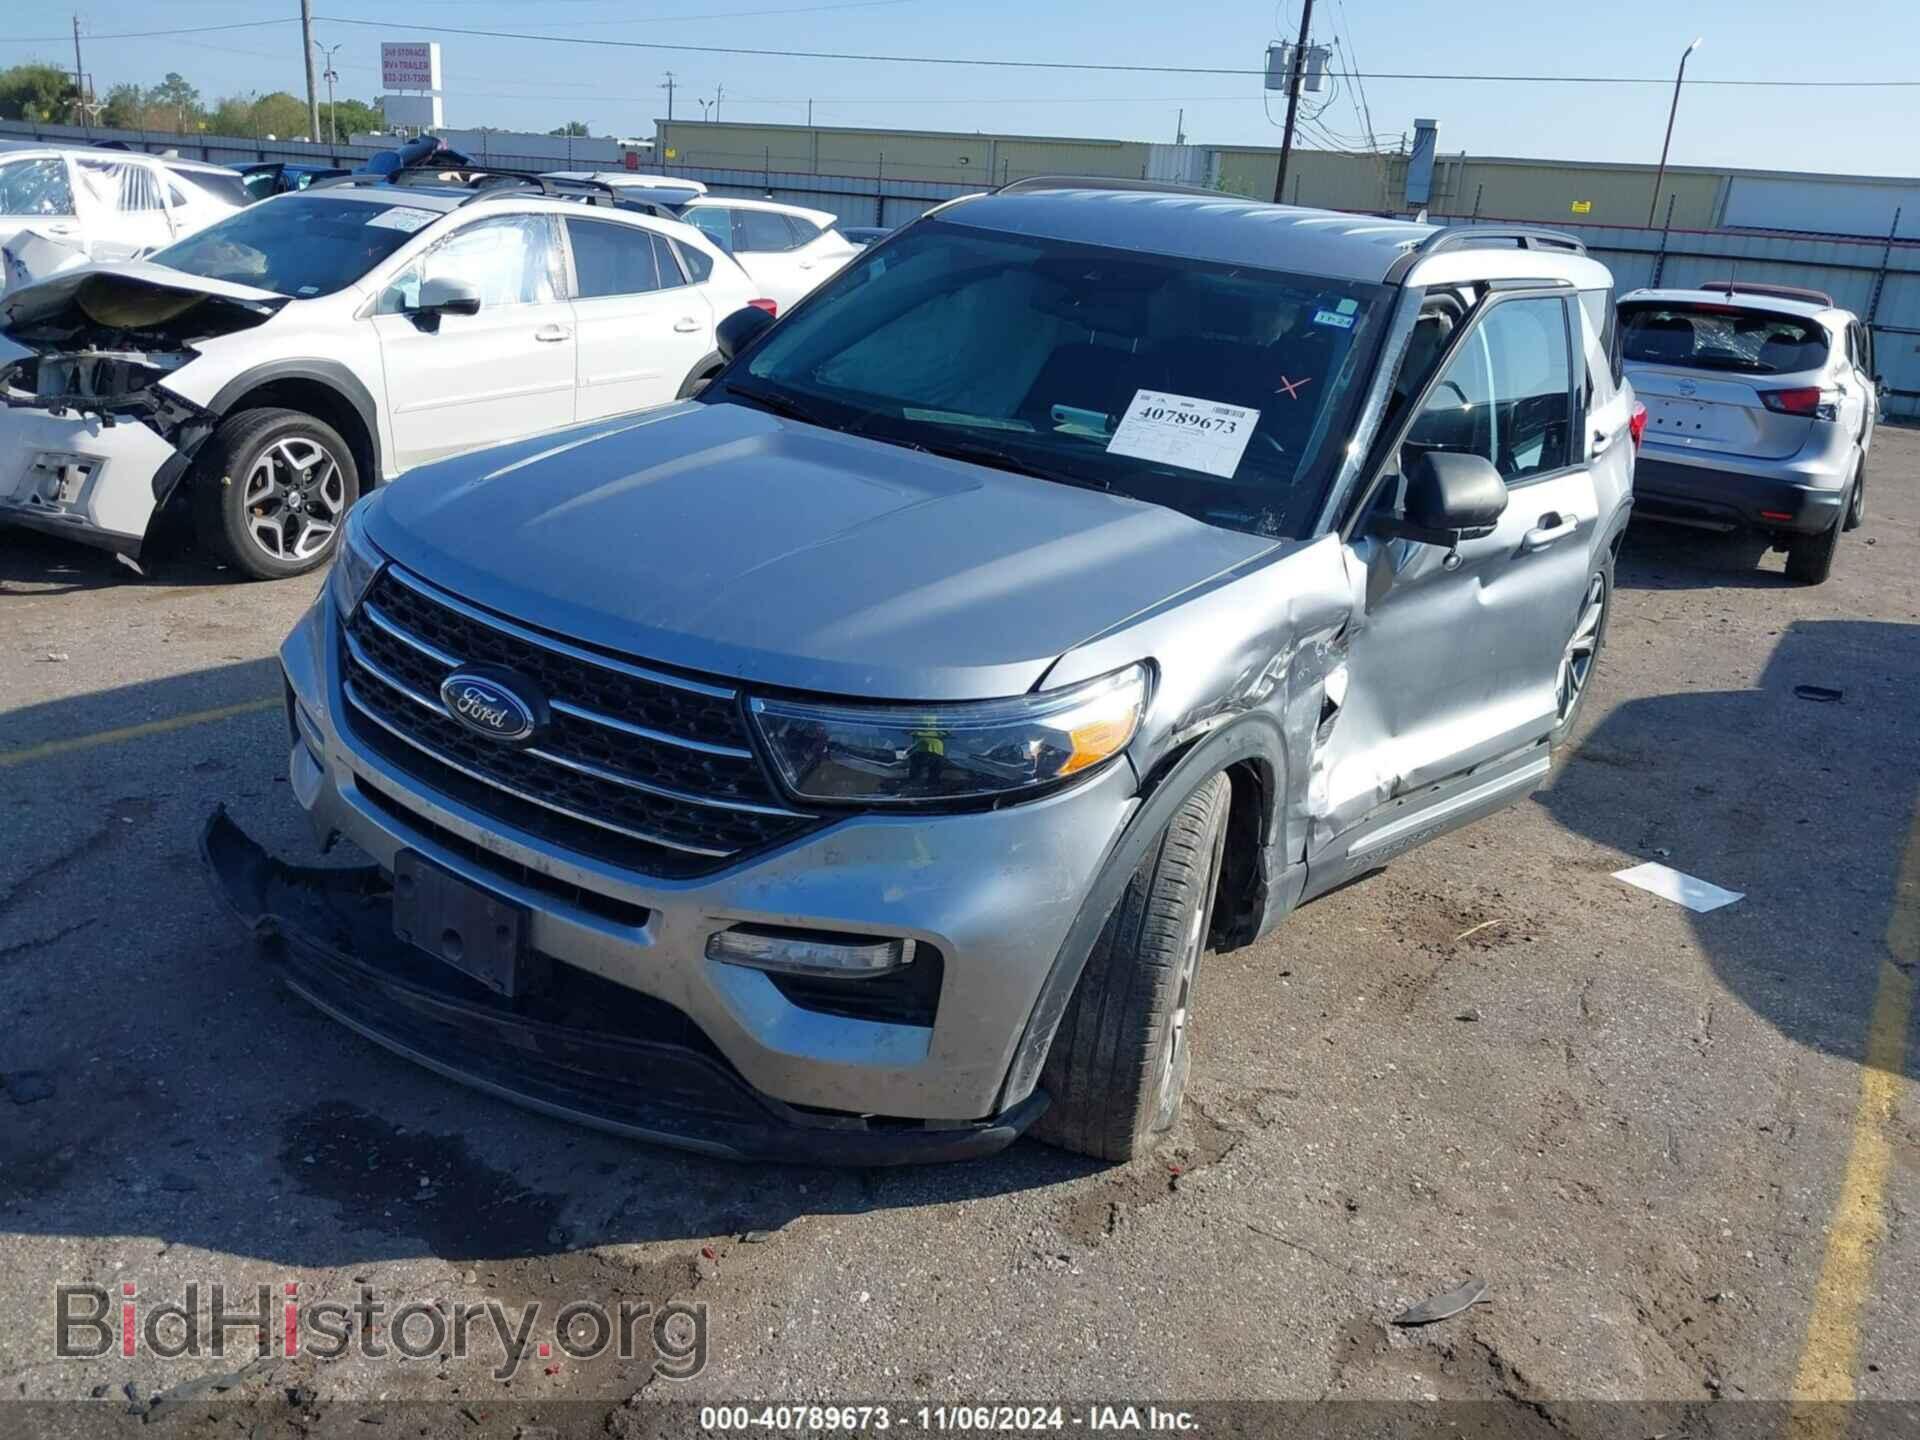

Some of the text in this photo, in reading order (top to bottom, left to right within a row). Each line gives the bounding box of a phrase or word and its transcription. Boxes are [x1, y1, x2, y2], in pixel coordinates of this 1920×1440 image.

[398, 48, 426, 57] STORAGE
[400, 61, 429, 70] TRAILER
[1139, 406, 1237, 434] 40789673
[457, 687, 508, 728] Ford
